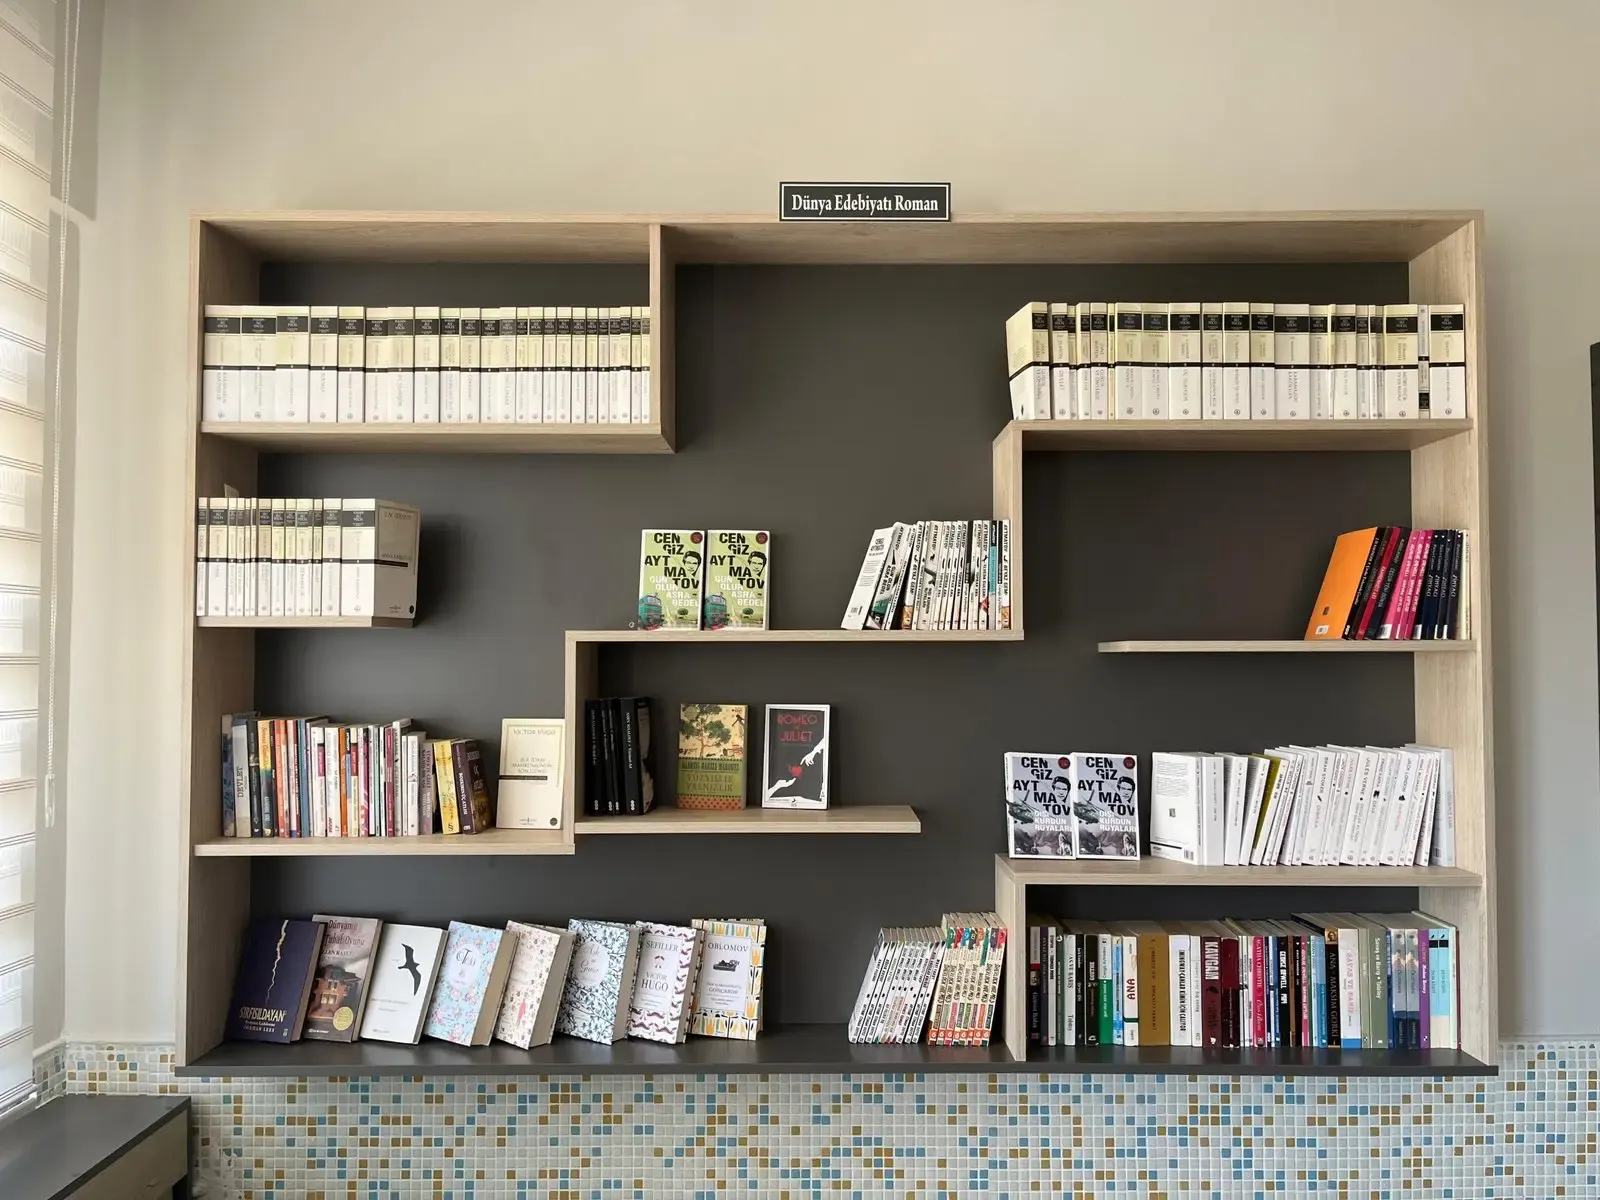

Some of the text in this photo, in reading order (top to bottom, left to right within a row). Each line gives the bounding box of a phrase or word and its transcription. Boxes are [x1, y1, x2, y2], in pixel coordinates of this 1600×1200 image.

[791, 193, 939, 216] Dünya Edebiyatı Roman
[654, 533, 680, 543] CEN
[719, 533, 746, 543] CEN
[645, 555, 671, 566] AYT
[710, 555, 736, 566] AYT
[664, 566, 687, 577] MA
[729, 566, 752, 577] MA
[672, 578, 699, 589] TOV
[737, 578, 764, 589] TOV
[777, 713, 818, 725] ROMEO
[780, 731, 813, 743] JULIET
[1021, 757, 1049, 768] CEN
[1086, 757, 1113, 768] CEN
[236, 766, 244, 798] DEVLET
[1013, 780, 1040, 791] AYT
[1078, 780, 1104, 791] AYT
[1033, 792, 1057, 803] MA
[1098, 792, 1122, 803] MA
[1043, 804, 1071, 816] TOV
[1108, 804, 1135, 816] TOV
[707, 942, 749, 953] OBLOMOV
[1204, 941, 1220, 980] KAVGAM
[640, 979, 669, 993] HUGO
[1127, 978, 1136, 1000] ANA
